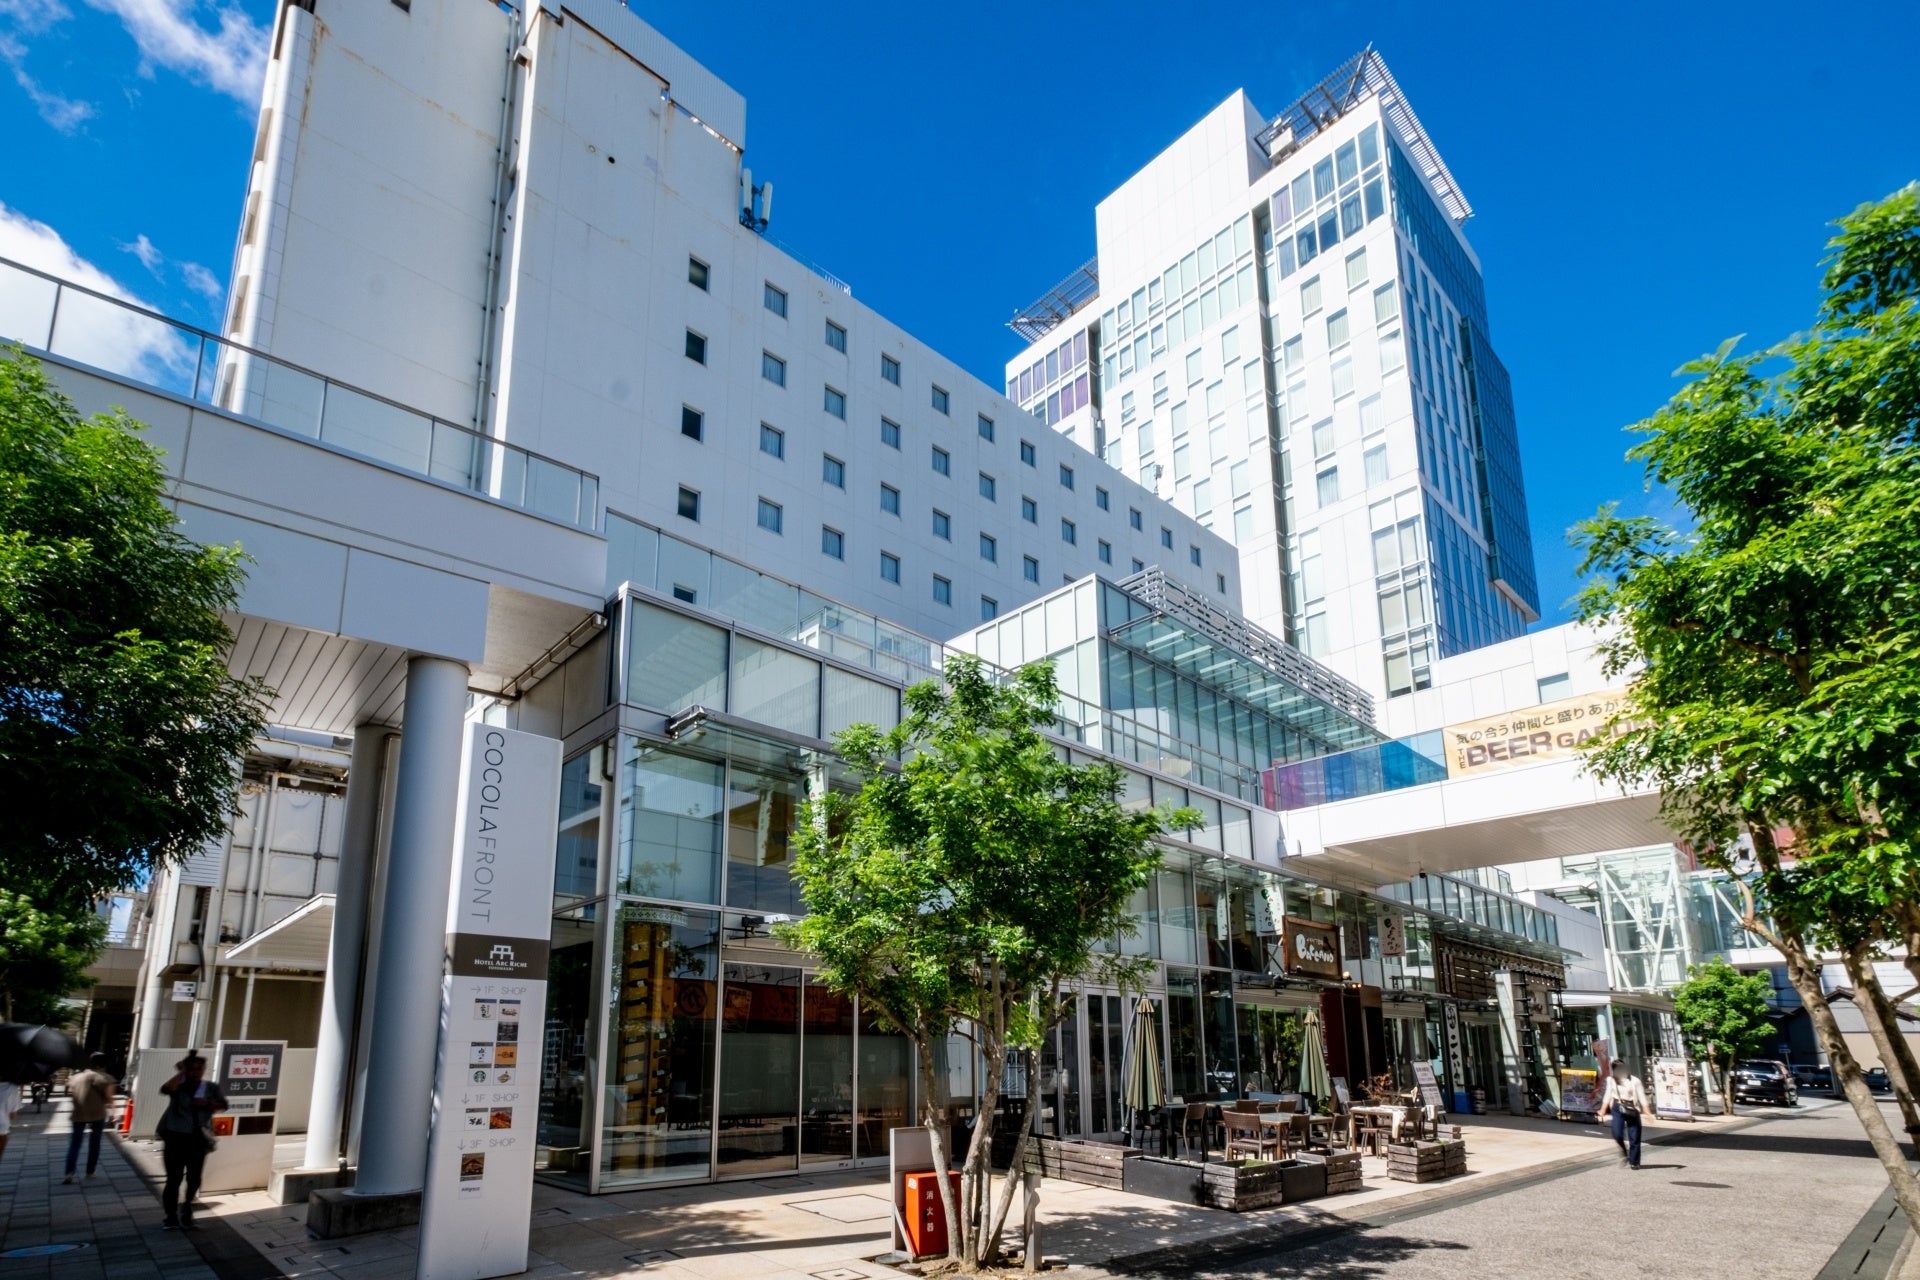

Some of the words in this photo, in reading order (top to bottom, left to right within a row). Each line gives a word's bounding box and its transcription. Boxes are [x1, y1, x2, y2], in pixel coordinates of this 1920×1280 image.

[1457, 749, 1466, 769] THE
[1466, 731, 1553, 767] BEER
[501, 986, 527, 995] SHOP
[234, 1057, 270, 1066] 一般車両
[232, 1067, 268, 1076] 進入禁止
[230, 1081, 267, 1091] 出入口
[492, 1092, 519, 1102] SHOP
[470, 1139, 482, 1149] 3F
[489, 1138, 516, 1148] SHOP
[926, 1190, 934, 1233] 消火器
